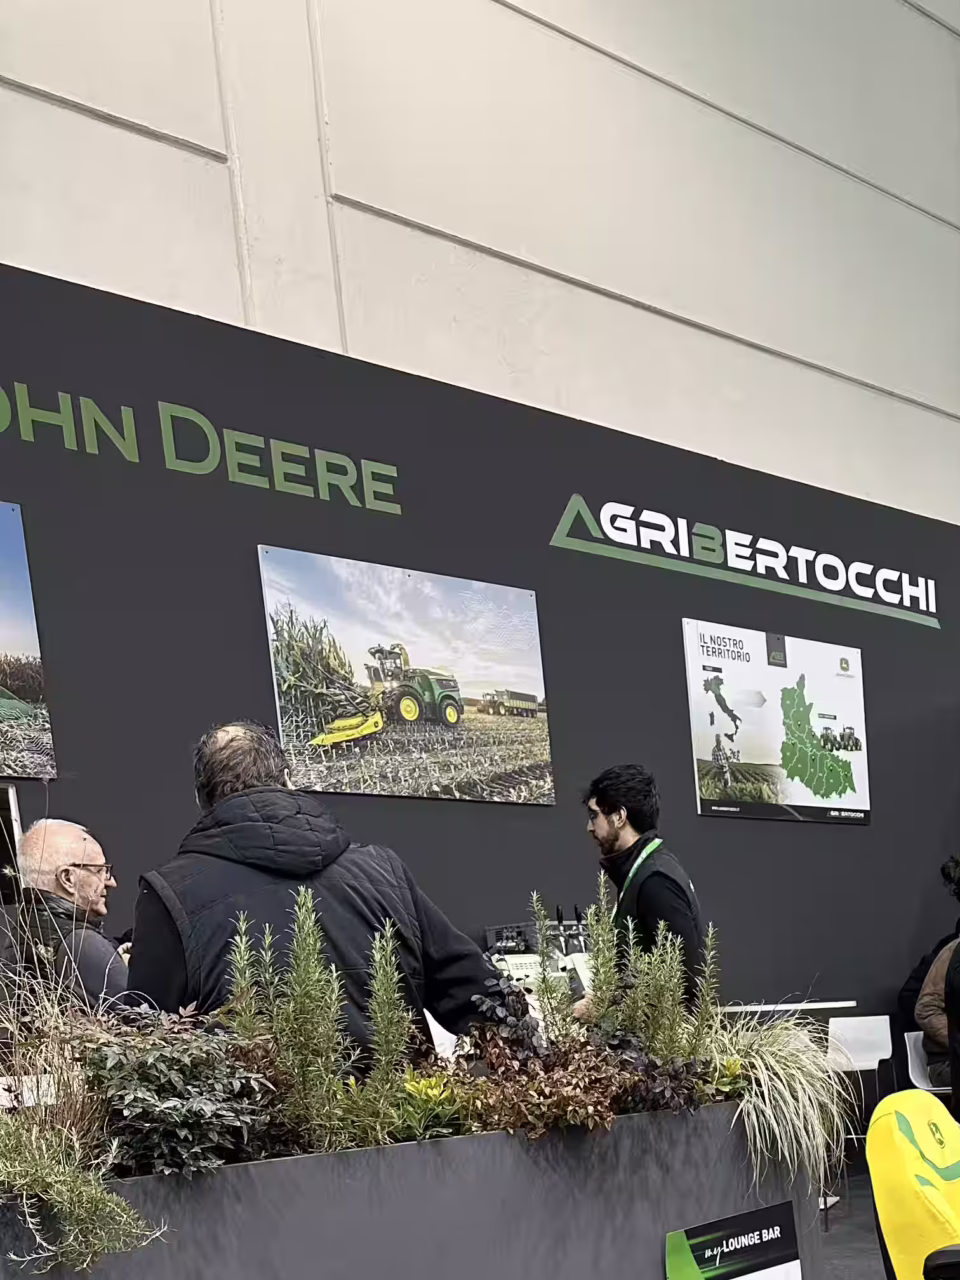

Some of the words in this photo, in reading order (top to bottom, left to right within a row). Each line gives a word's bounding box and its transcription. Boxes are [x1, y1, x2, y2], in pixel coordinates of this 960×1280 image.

[0, 382, 140, 463] HN
[158, 401, 402, 516] DEERE
[549, 493, 938, 613] AGRIBERTOCCHI
[700, 633, 709, 645] IL
[710, 635, 744, 651] NOSTRO
[700, 645, 751, 663] TERRITORIO
[761, 1226, 781, 1242] BAR
